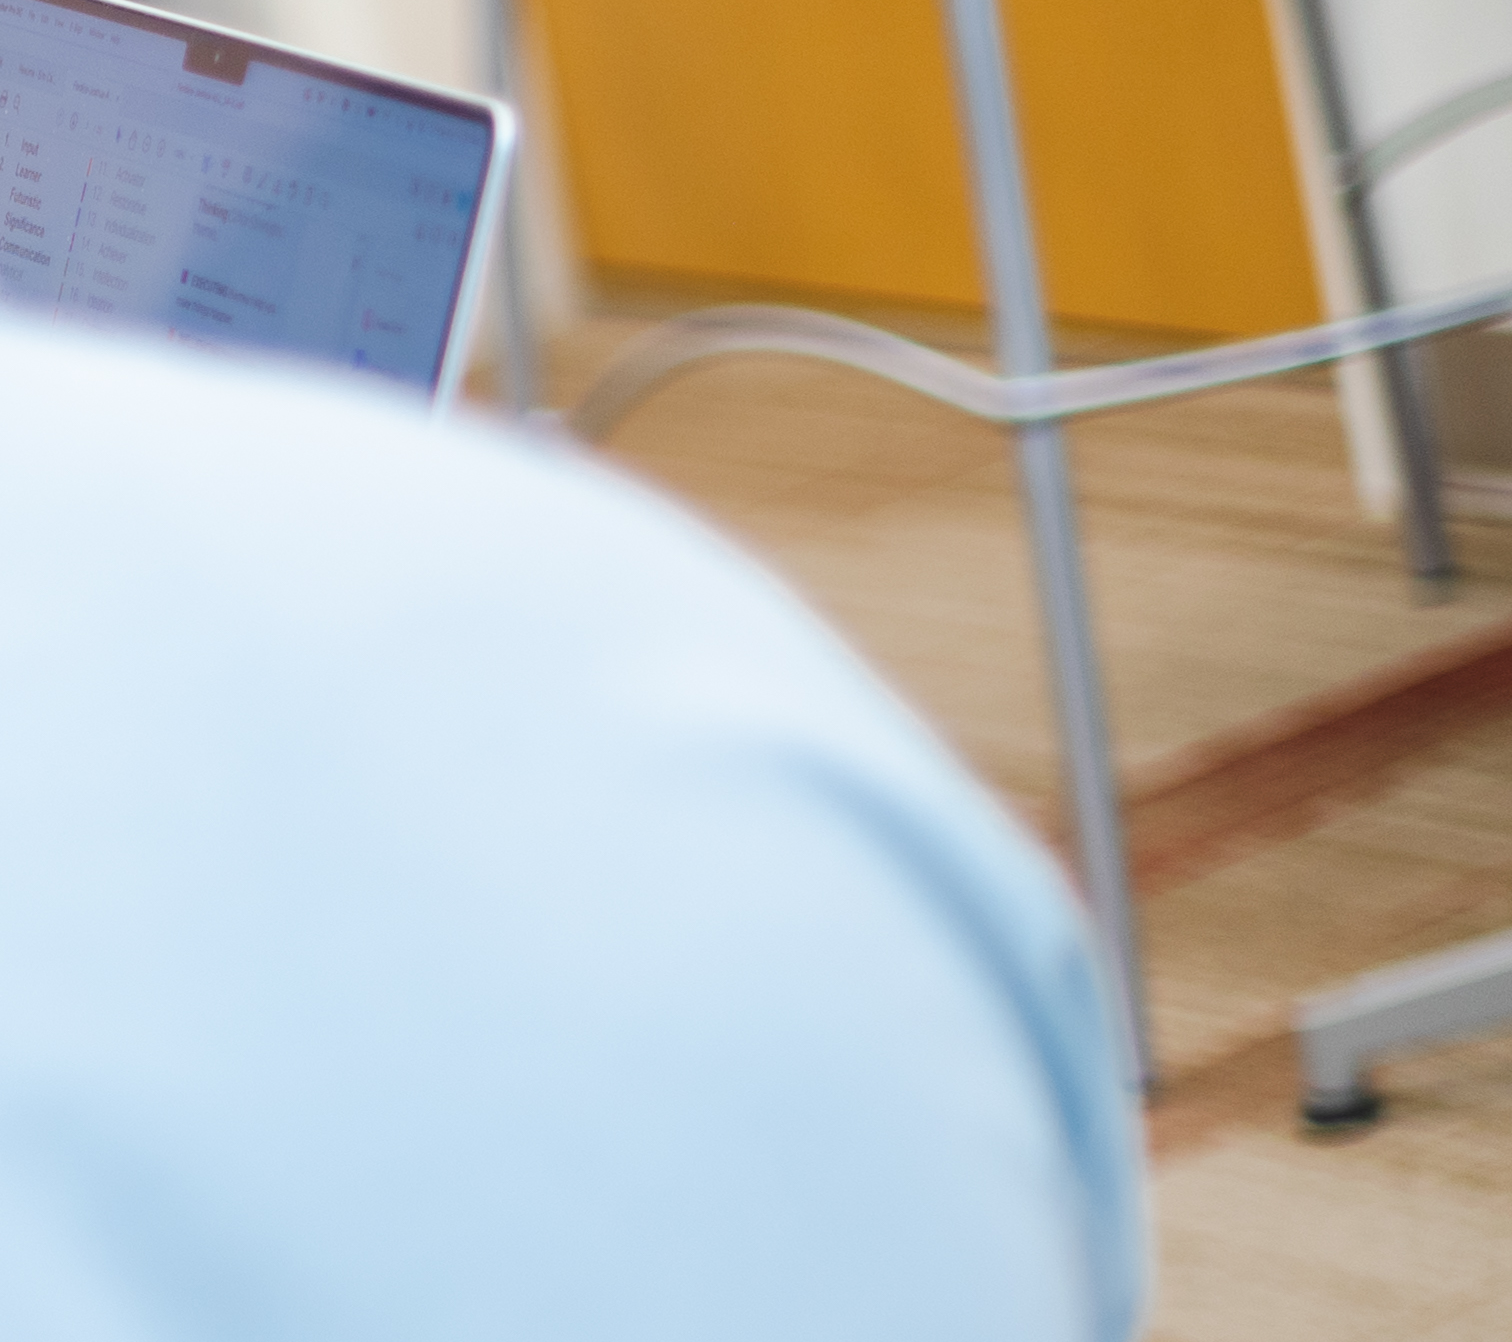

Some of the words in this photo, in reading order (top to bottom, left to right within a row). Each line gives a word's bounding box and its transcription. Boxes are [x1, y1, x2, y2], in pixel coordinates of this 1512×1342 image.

[21, 138, 40, 156] Input
[15, 162, 43, 182] Learner
[10, 186, 42, 210] Futuristic
[4, 211, 45, 238] Significance
[0, 236, 51, 266] Communication
